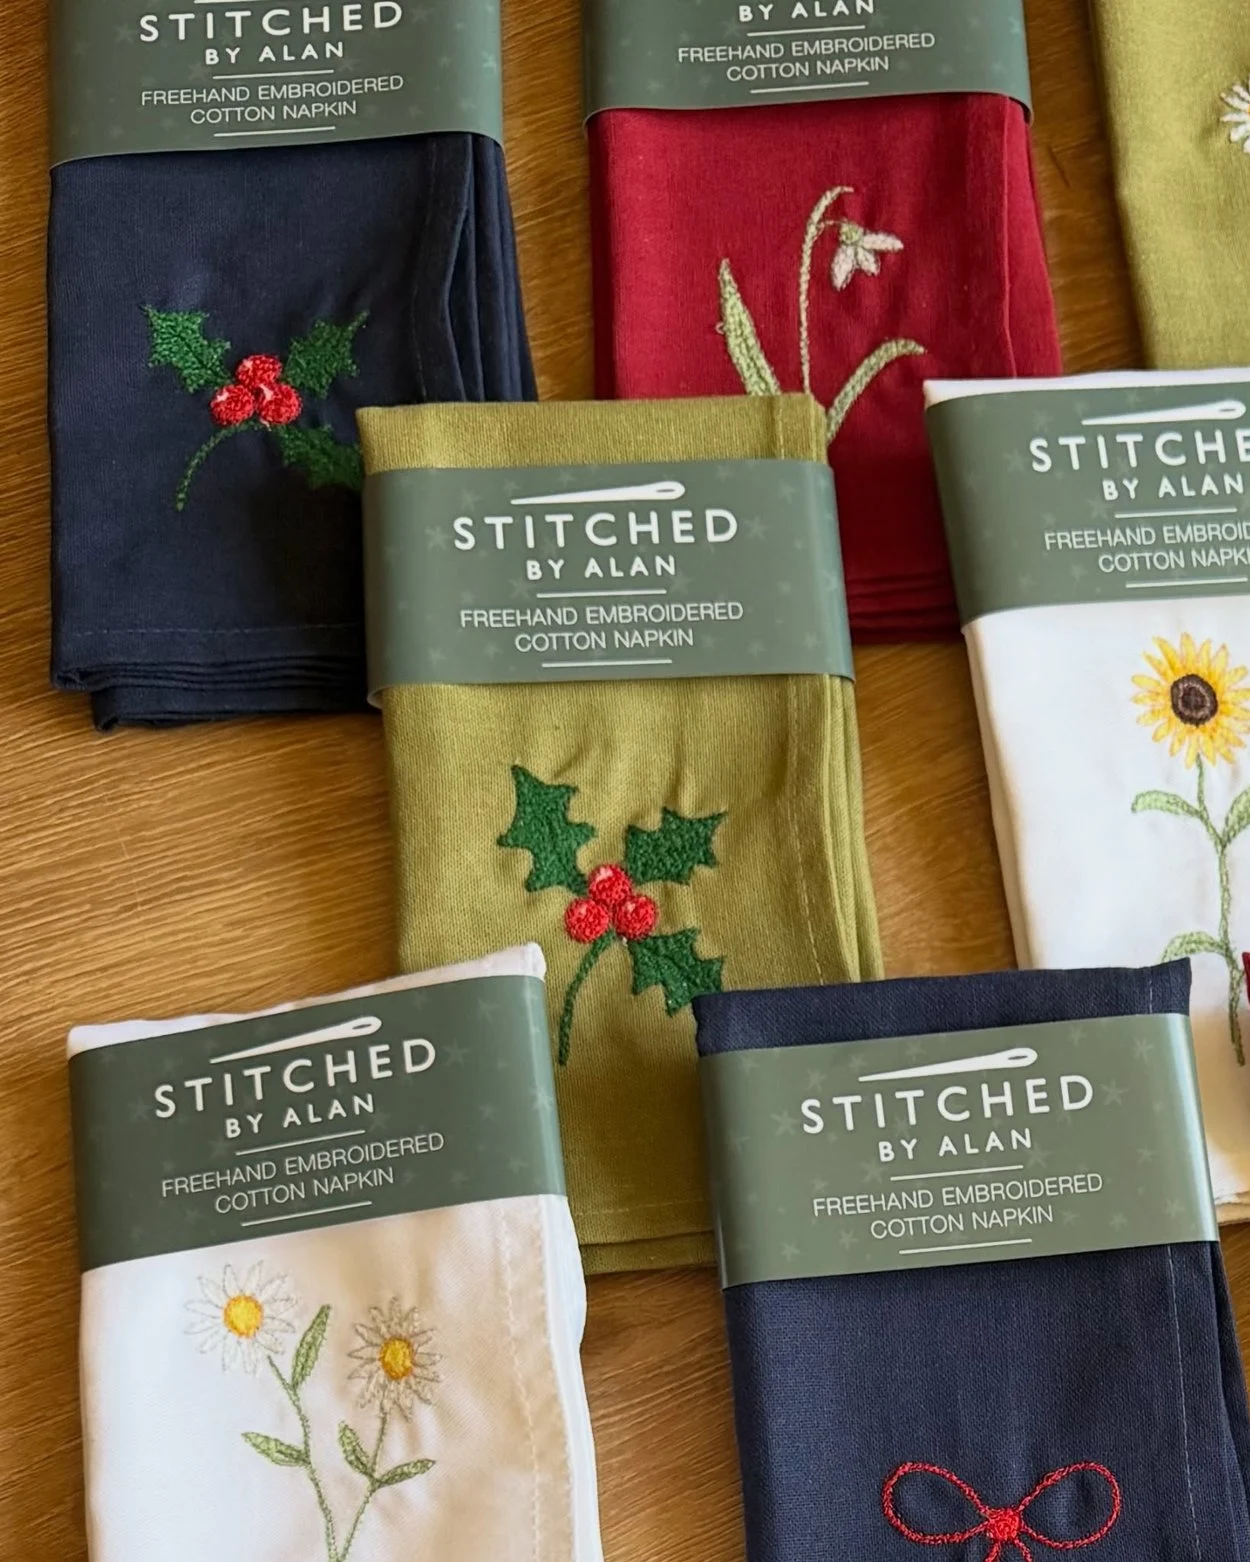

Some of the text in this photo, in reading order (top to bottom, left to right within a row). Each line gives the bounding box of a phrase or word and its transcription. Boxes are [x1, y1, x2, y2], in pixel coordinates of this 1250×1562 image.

[139, 1, 402, 42] STITCHED
[739, 0, 874, 22] BY ALAN
[205, 41, 343, 65] BY ALAN
[678, 33, 935, 63] FREEHAND EMBROIDERED
[727, 56, 889, 82] COTTON NAPKIN
[141, 75, 404, 106] FREEHAND EMBROIDERED
[190, 100, 357, 124] COTTON NAPKIN
[1102, 472, 1244, 501] BY ALAN
[453, 509, 738, 550] STITCHED
[1044, 527, 1156, 550] FREEHAND
[527, 555, 675, 580] BY ALAN
[1098, 549, 1185, 573] COTTON
[460, 602, 744, 628] FREEHAND EMBROIDERED
[514, 628, 694, 652] COTTON NAPKIN
[154, 1038, 436, 1118] STITCHED
[225, 1093, 374, 1138] BY ALAN
[801, 1075, 1093, 1134] STITCHED
[878, 1127, 1031, 1162] BY ALAN
[162, 1132, 444, 1197] FREEHAND EMBROIDERED
[215, 1166, 394, 1214] COTTON NAPKIN
[813, 1173, 1103, 1217] FREEHAND EMBROIDERED
[870, 1204, 1053, 1239] COTTON NAPKIN
